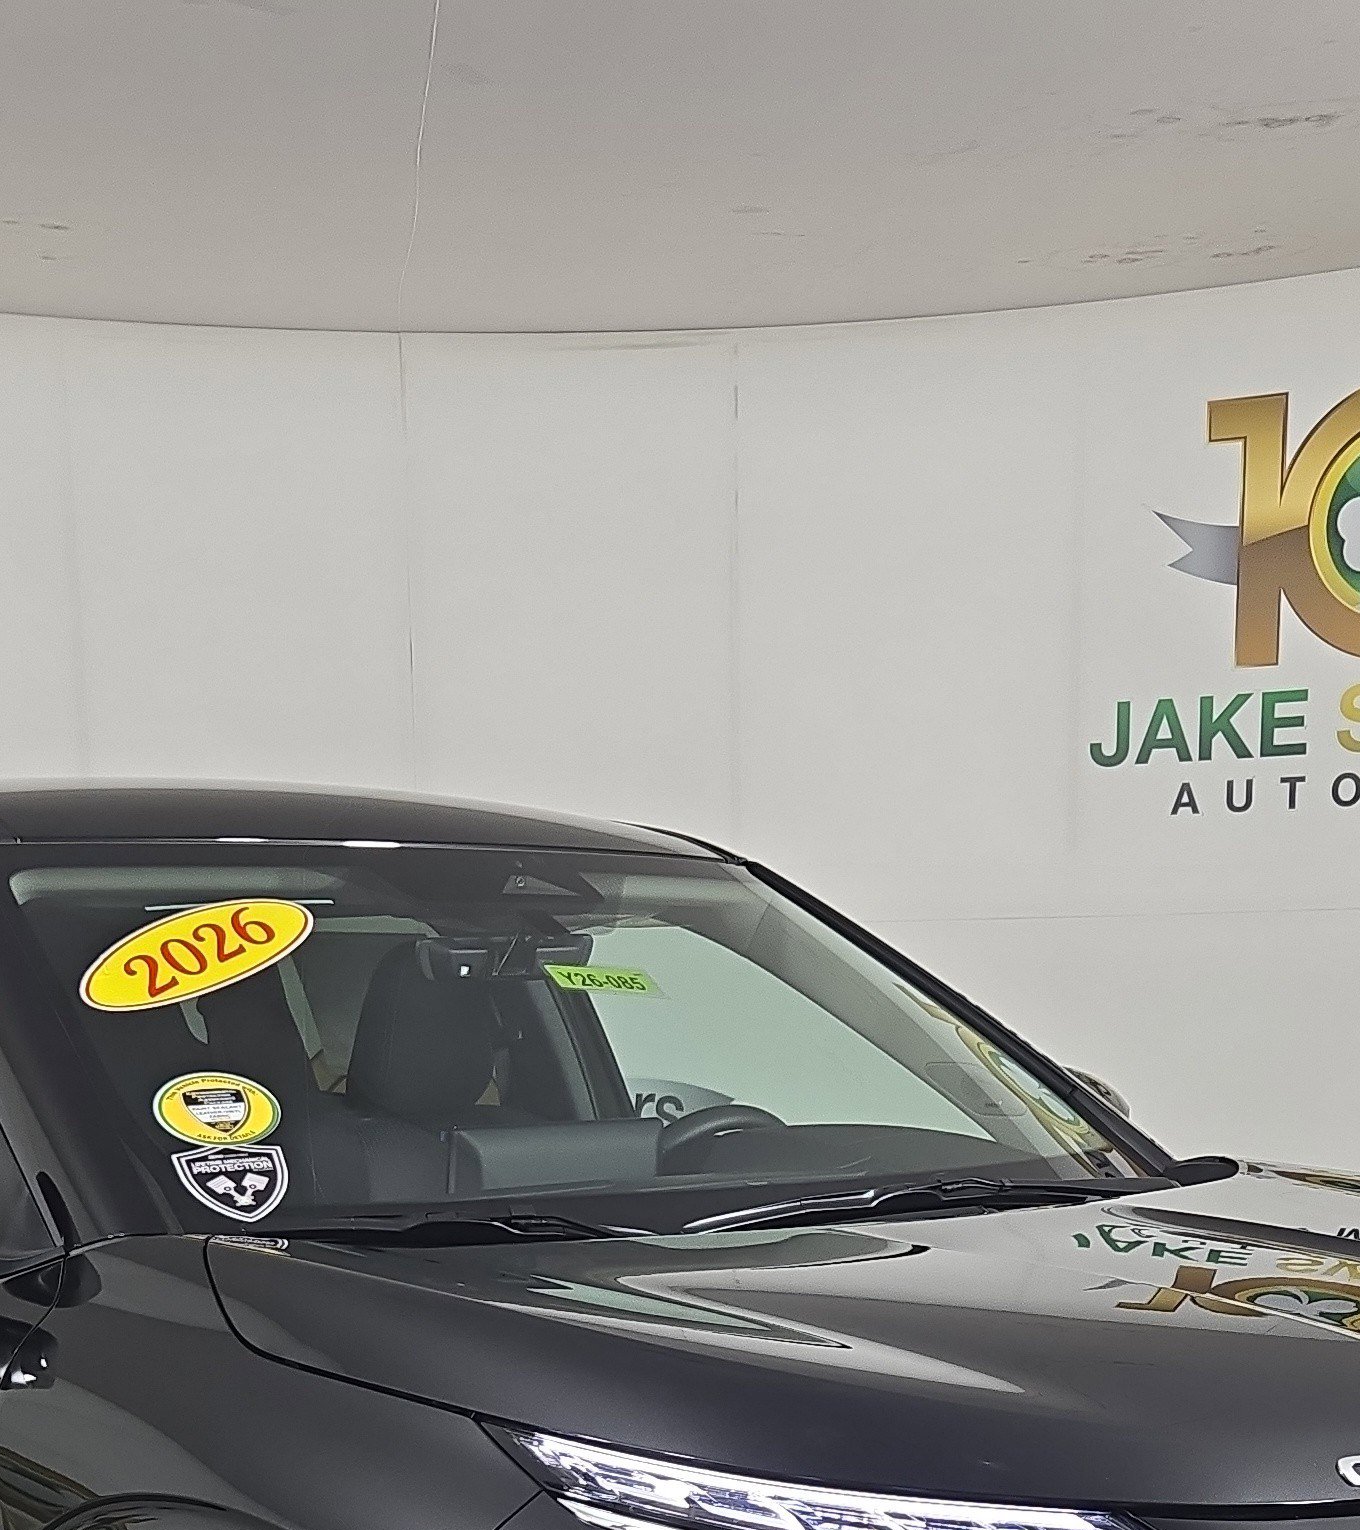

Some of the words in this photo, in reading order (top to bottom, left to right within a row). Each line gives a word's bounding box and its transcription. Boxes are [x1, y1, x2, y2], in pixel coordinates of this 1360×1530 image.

[1089, 688, 1309, 768] JAKE
[123, 906, 277, 999] 2026
[557, 970, 647, 990] Y26-085
[192, 1160, 274, 1174] PROTECTION
